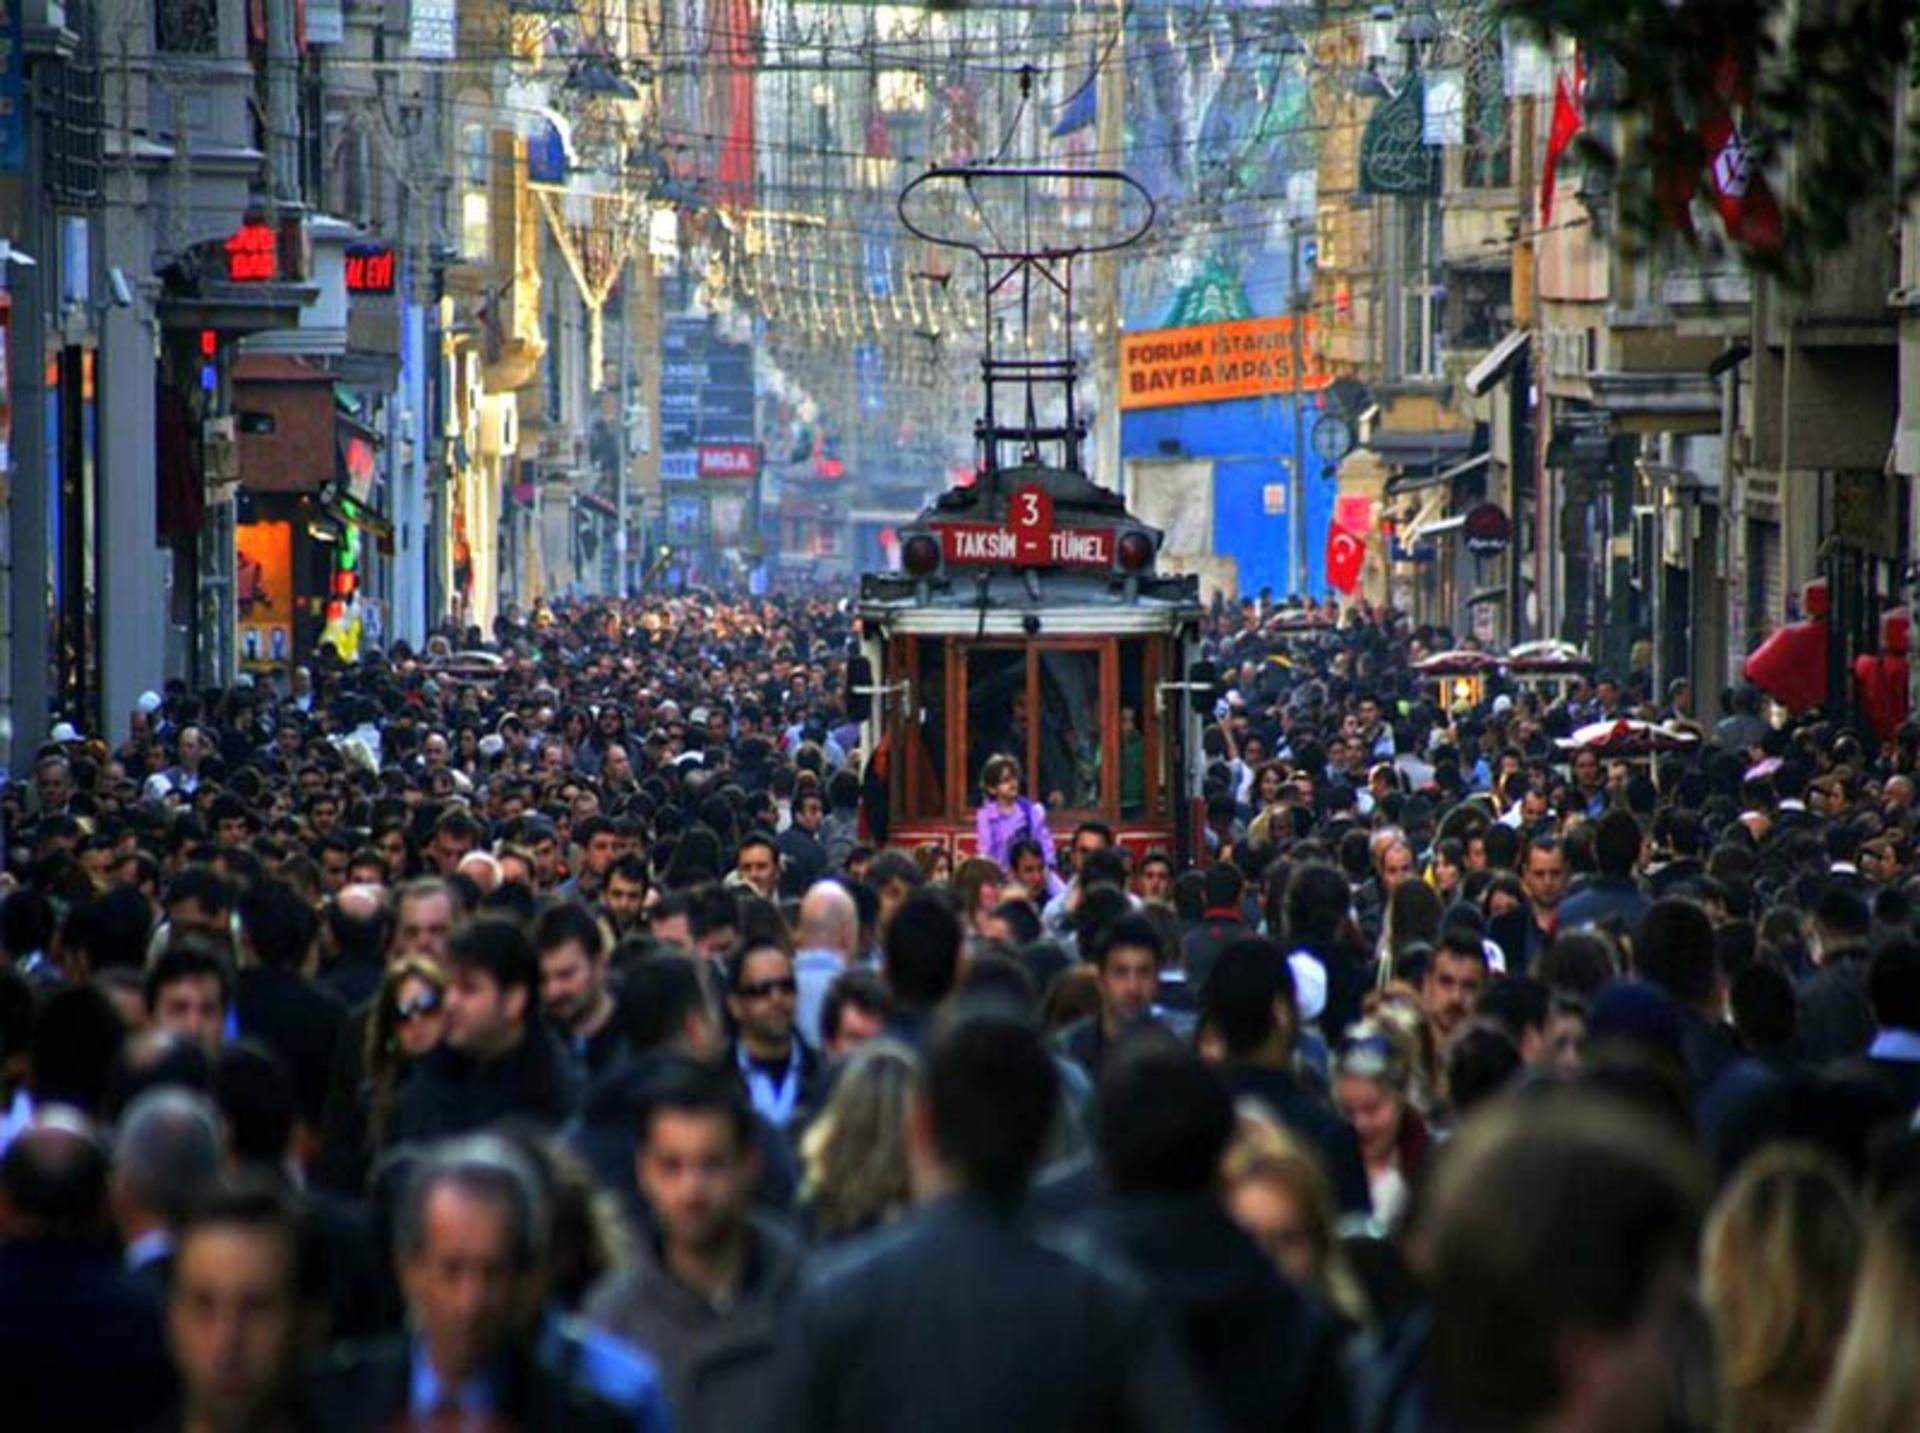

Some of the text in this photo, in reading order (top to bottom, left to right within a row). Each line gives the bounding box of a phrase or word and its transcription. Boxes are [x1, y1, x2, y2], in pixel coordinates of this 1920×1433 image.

[1128, 340, 1203, 366] FORUM
[1021, 493, 1039, 526] 3
[954, 528, 1016, 558] TAKSİM
[1049, 529, 1107, 563] TÜNEL
